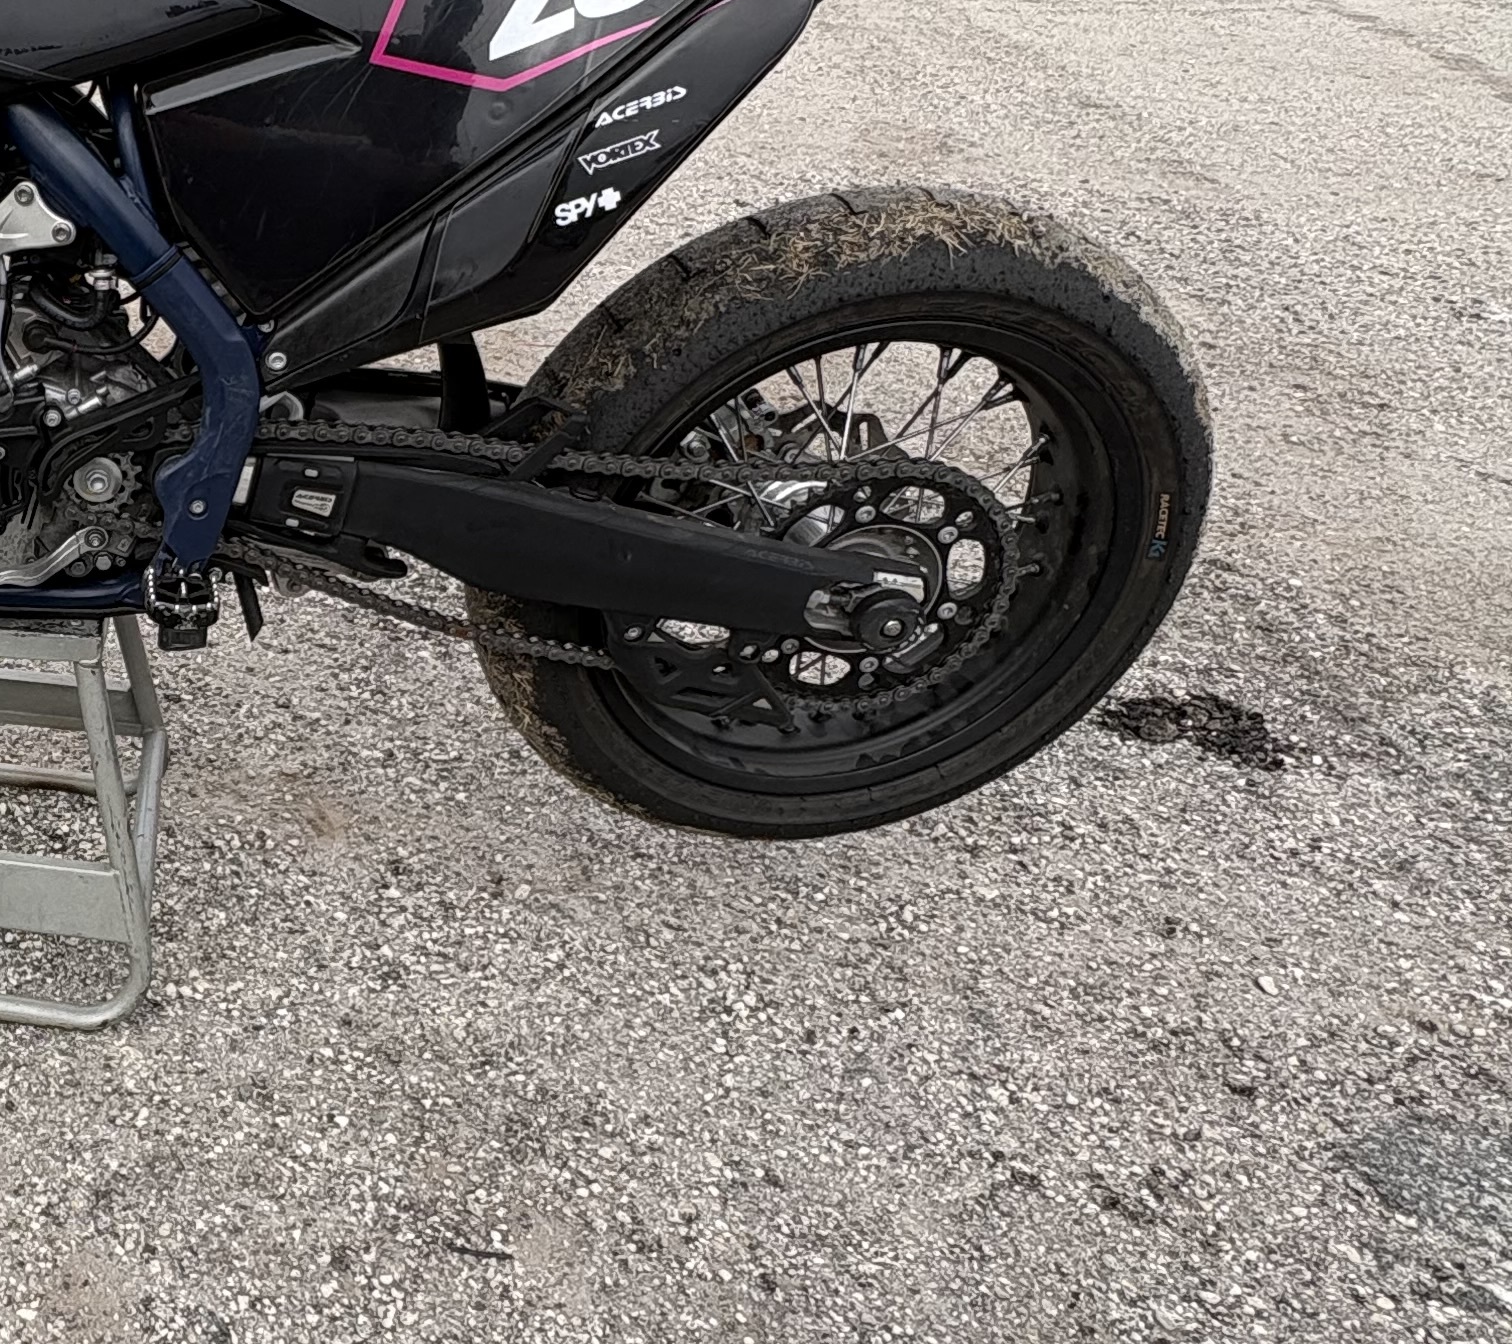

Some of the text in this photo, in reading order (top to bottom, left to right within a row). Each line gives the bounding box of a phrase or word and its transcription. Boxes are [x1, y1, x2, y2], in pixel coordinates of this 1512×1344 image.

[594, 85, 688, 128] ACERBIS
[577, 128, 662, 175] VORTEX
[1155, 493, 1170, 539] RACETEC
